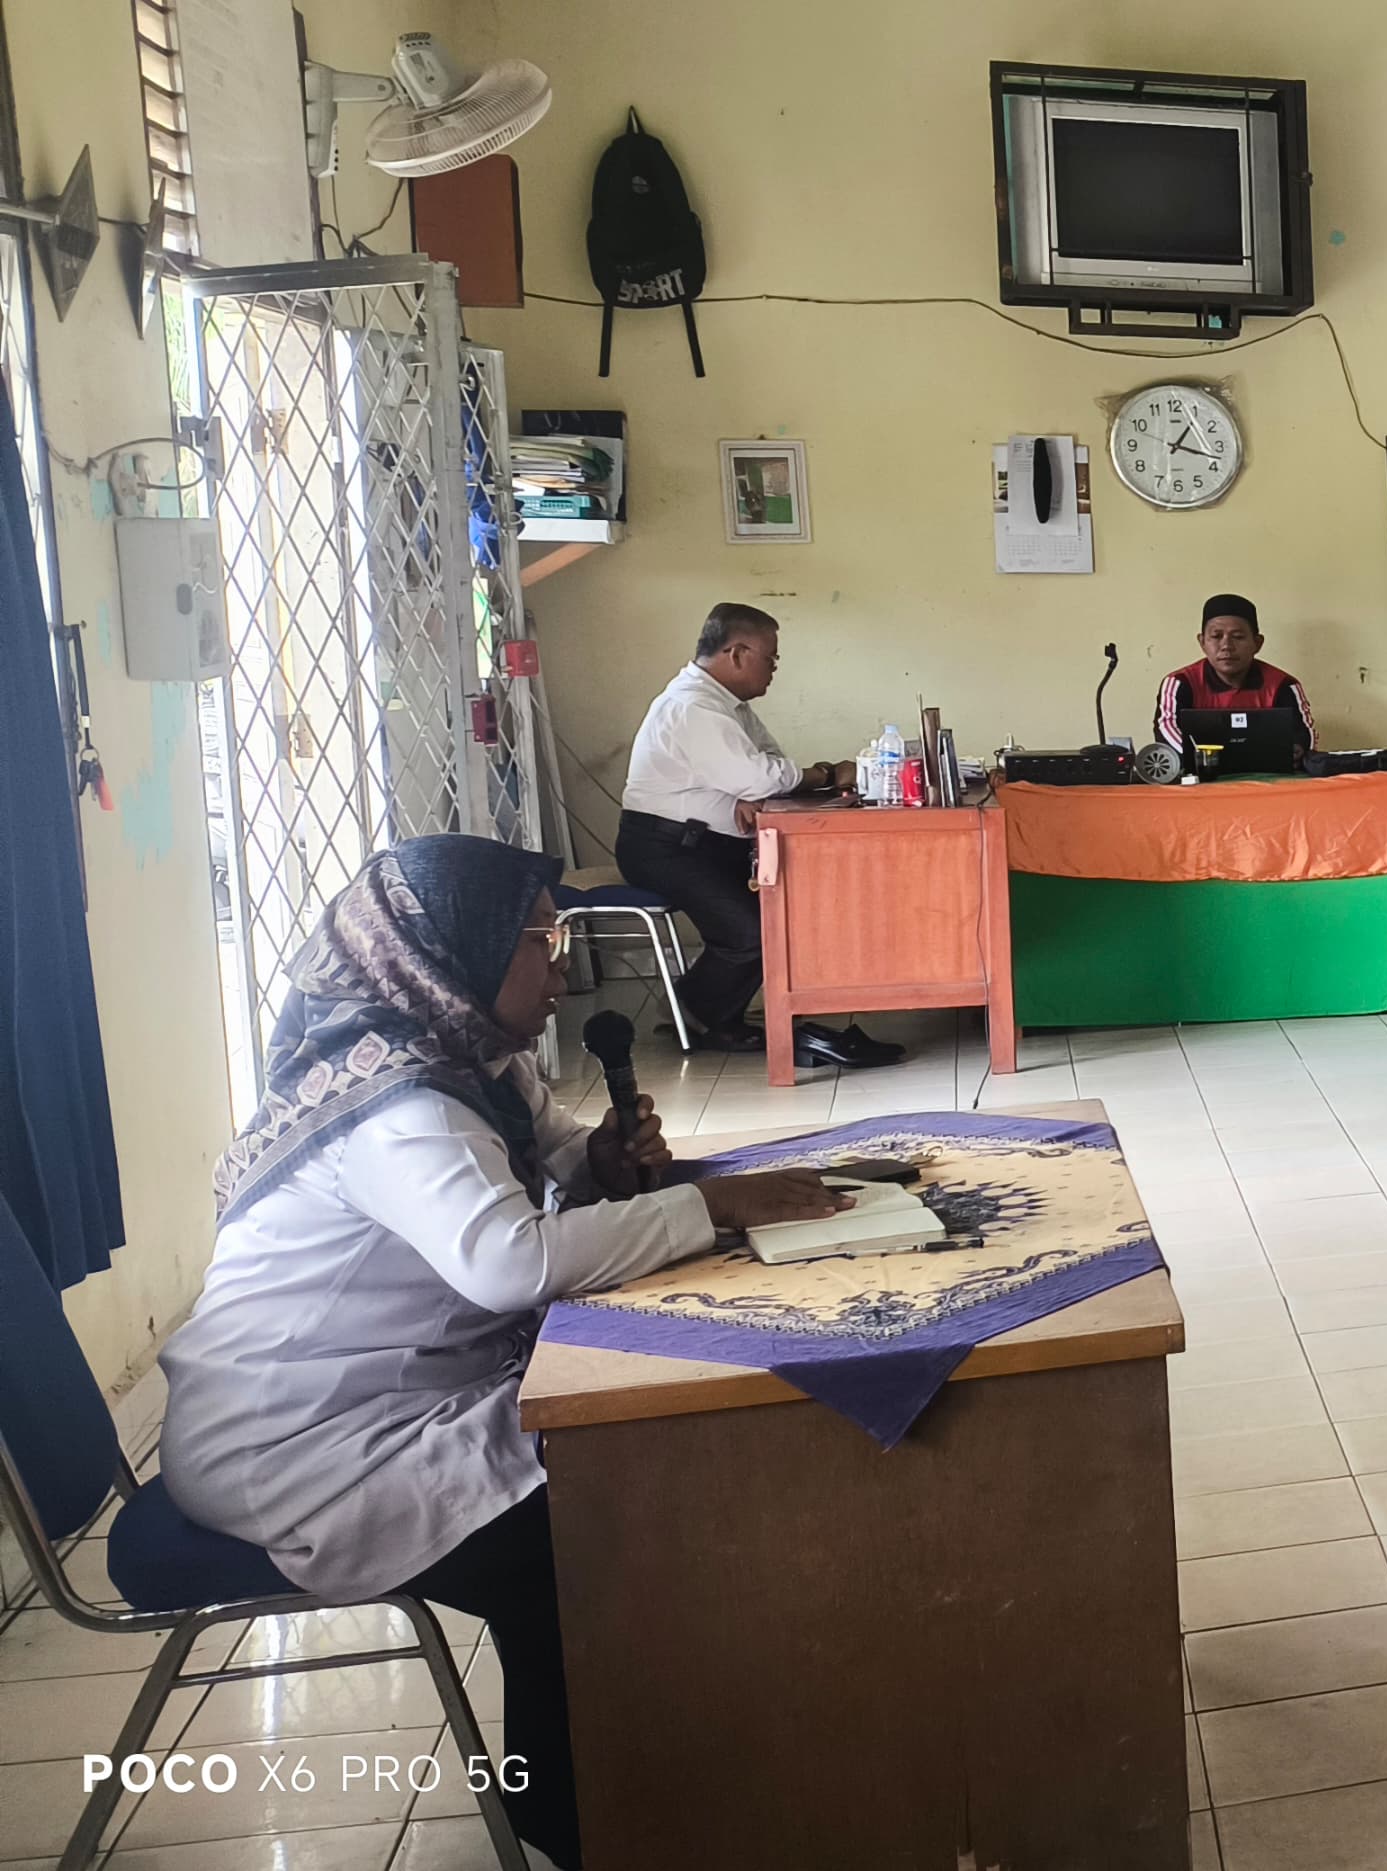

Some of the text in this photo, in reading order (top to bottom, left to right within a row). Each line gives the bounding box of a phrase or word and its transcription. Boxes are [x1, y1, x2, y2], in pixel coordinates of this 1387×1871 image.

[1149, 403, 1160, 416] 11
[1167, 399, 1182, 413] 12
[1192, 405, 1198, 417] 1
[1132, 418, 1147, 432] 10
[1207, 420, 1217, 433] 2
[1127, 439, 1138, 452] 9
[1214, 440, 1224, 453] 3
[1135, 459, 1145, 472] 8
[1208, 461, 1218, 472] 4
[1154, 475, 1164, 488] 7
[1173, 480, 1183, 492] 6
[1193, 475, 1203, 488] 5
